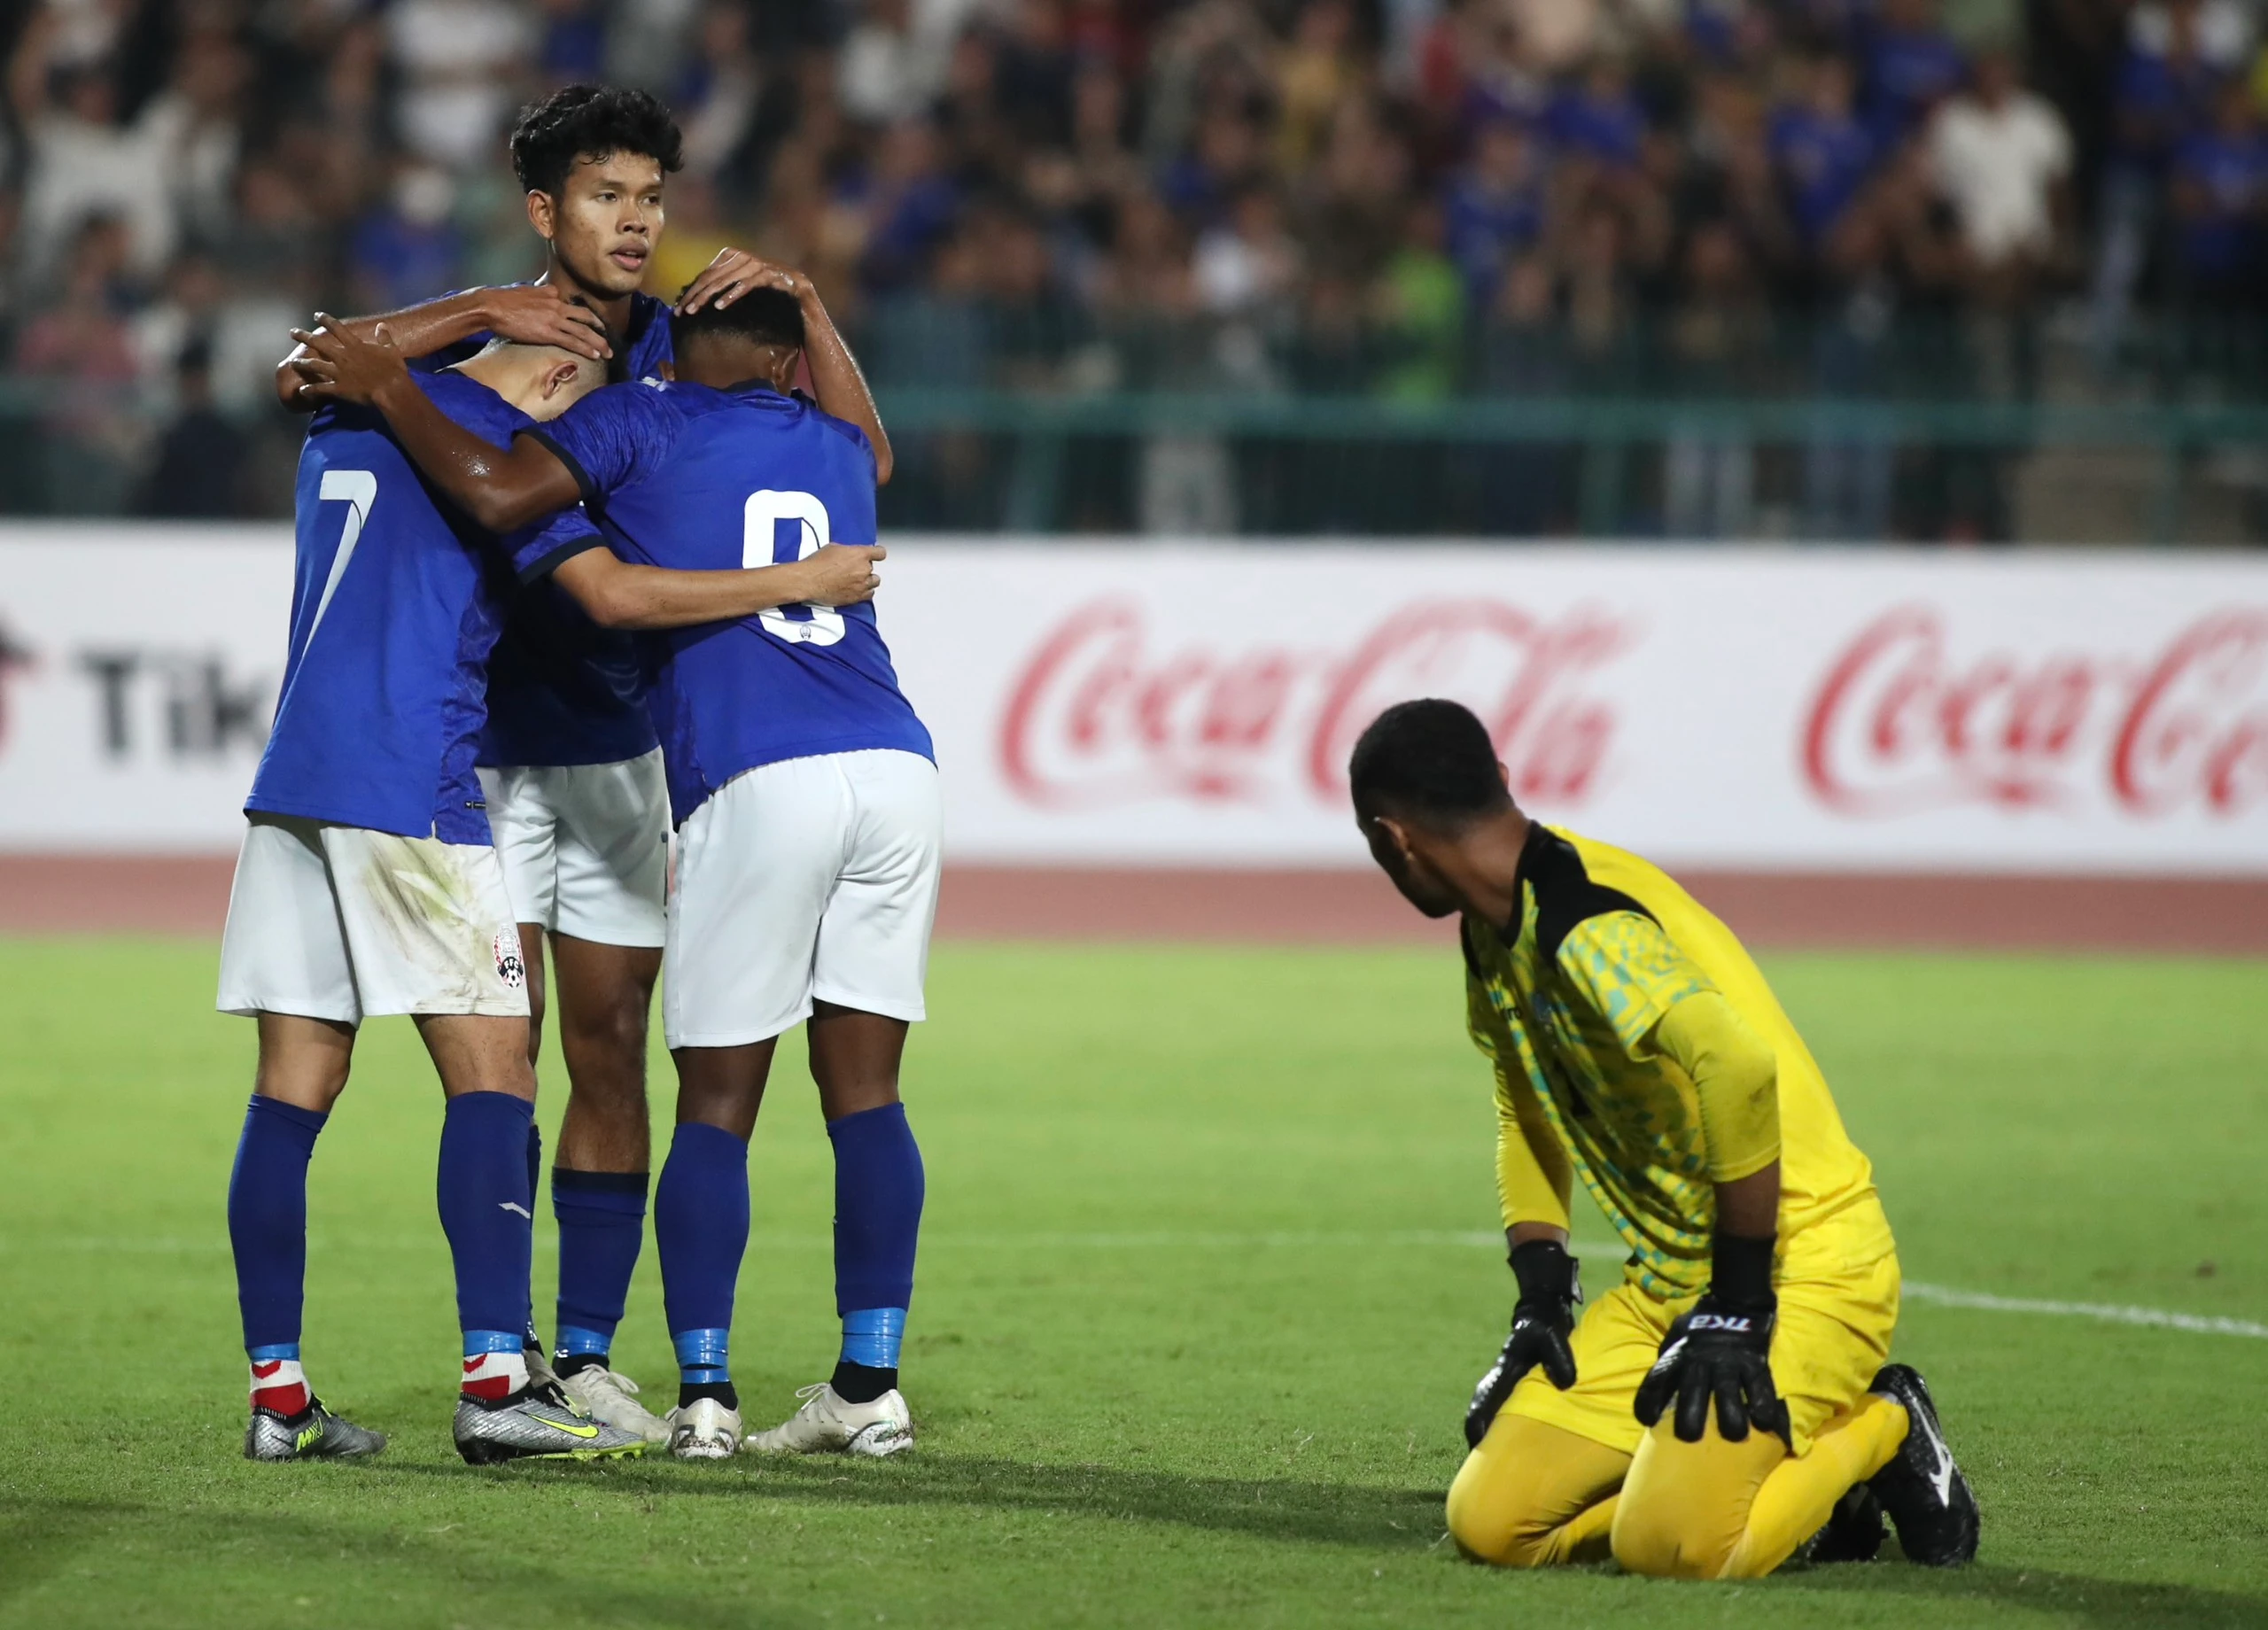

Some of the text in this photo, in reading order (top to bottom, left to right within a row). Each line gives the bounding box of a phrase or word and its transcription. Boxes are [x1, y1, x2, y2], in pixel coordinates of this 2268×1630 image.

[319, 470, 377, 657] 7
[76, 641, 271, 765] Tik
[994, 595, 1630, 808] Coca-Cla
[1802, 604, 2268, 813] Coca-Co
